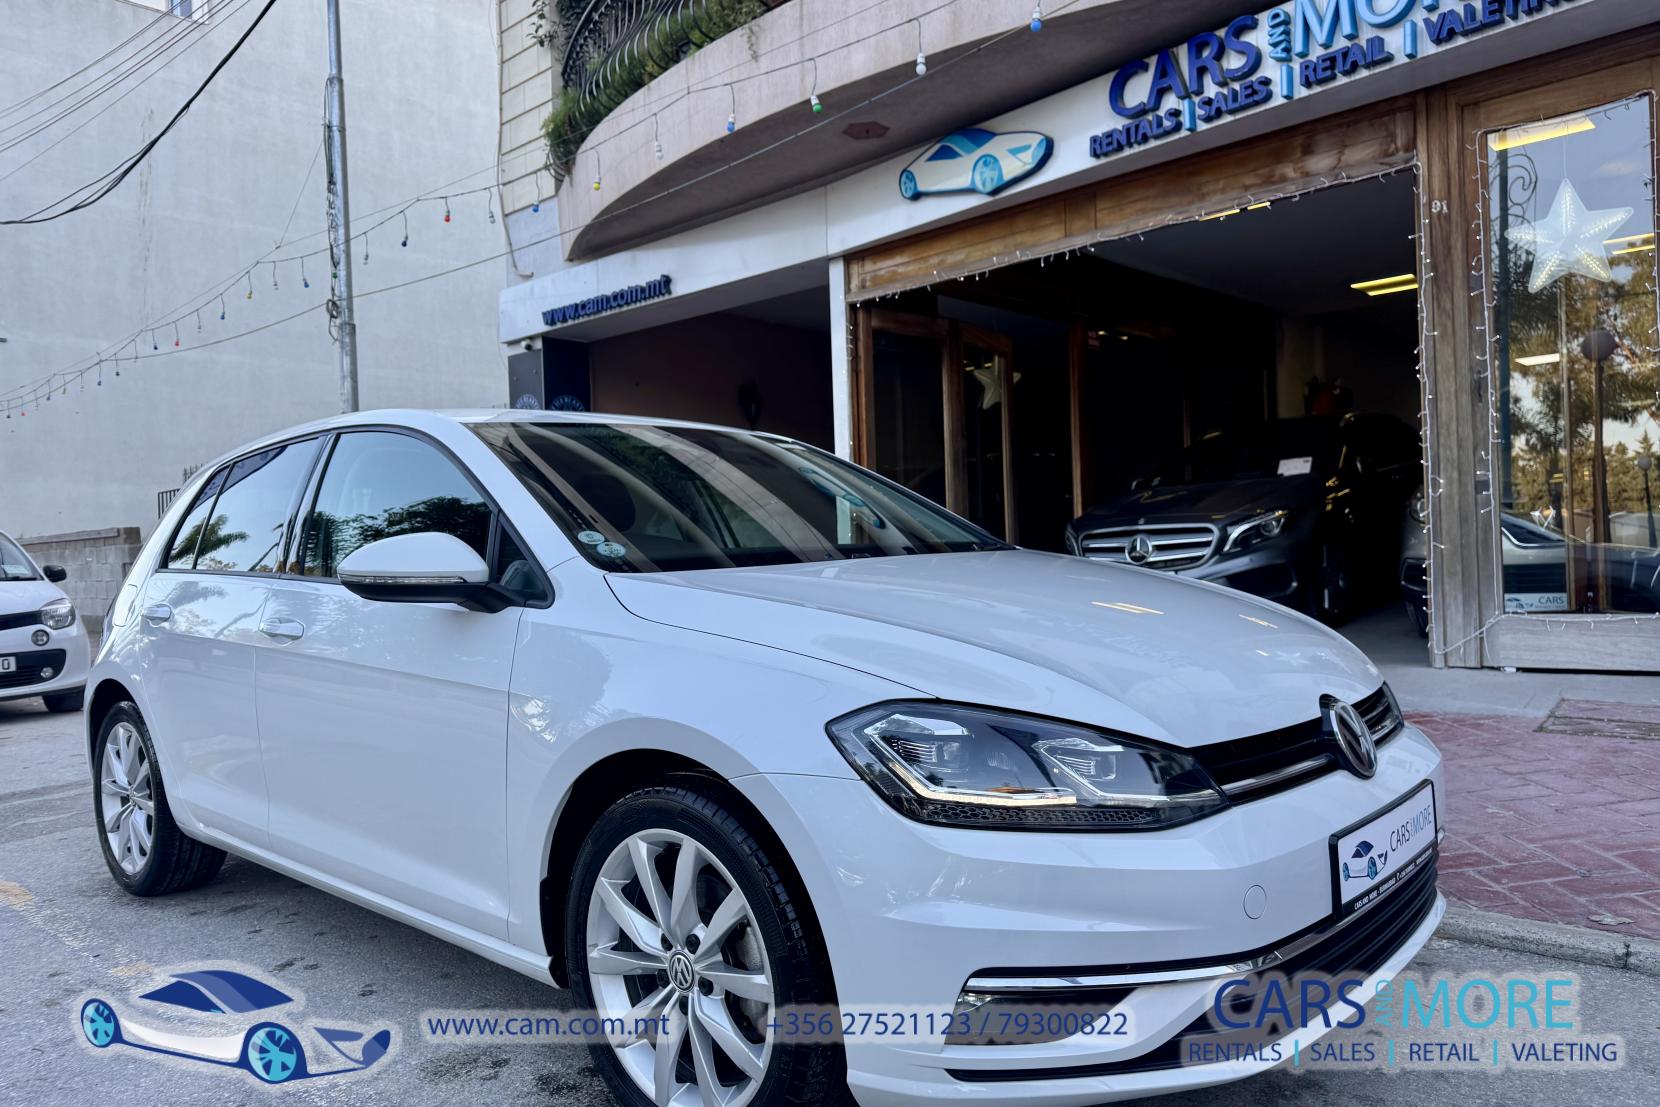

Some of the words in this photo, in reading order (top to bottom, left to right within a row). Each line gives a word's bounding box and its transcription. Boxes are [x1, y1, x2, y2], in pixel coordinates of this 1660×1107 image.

[1109, 14, 1262, 119] CARS
[1267, 7, 1292, 62] AND
[1090, 107, 1183, 158] RENTALS
[1197, 76, 1273, 122] SALES
[1299, 35, 1394, 88] RETAIL
[1431, 199, 1448, 215] 91
[541, 274, 672, 326] www.cam.com.mt
[1538, 595, 1565, 605] CARS
[1390, 821, 1410, 852] CARS
